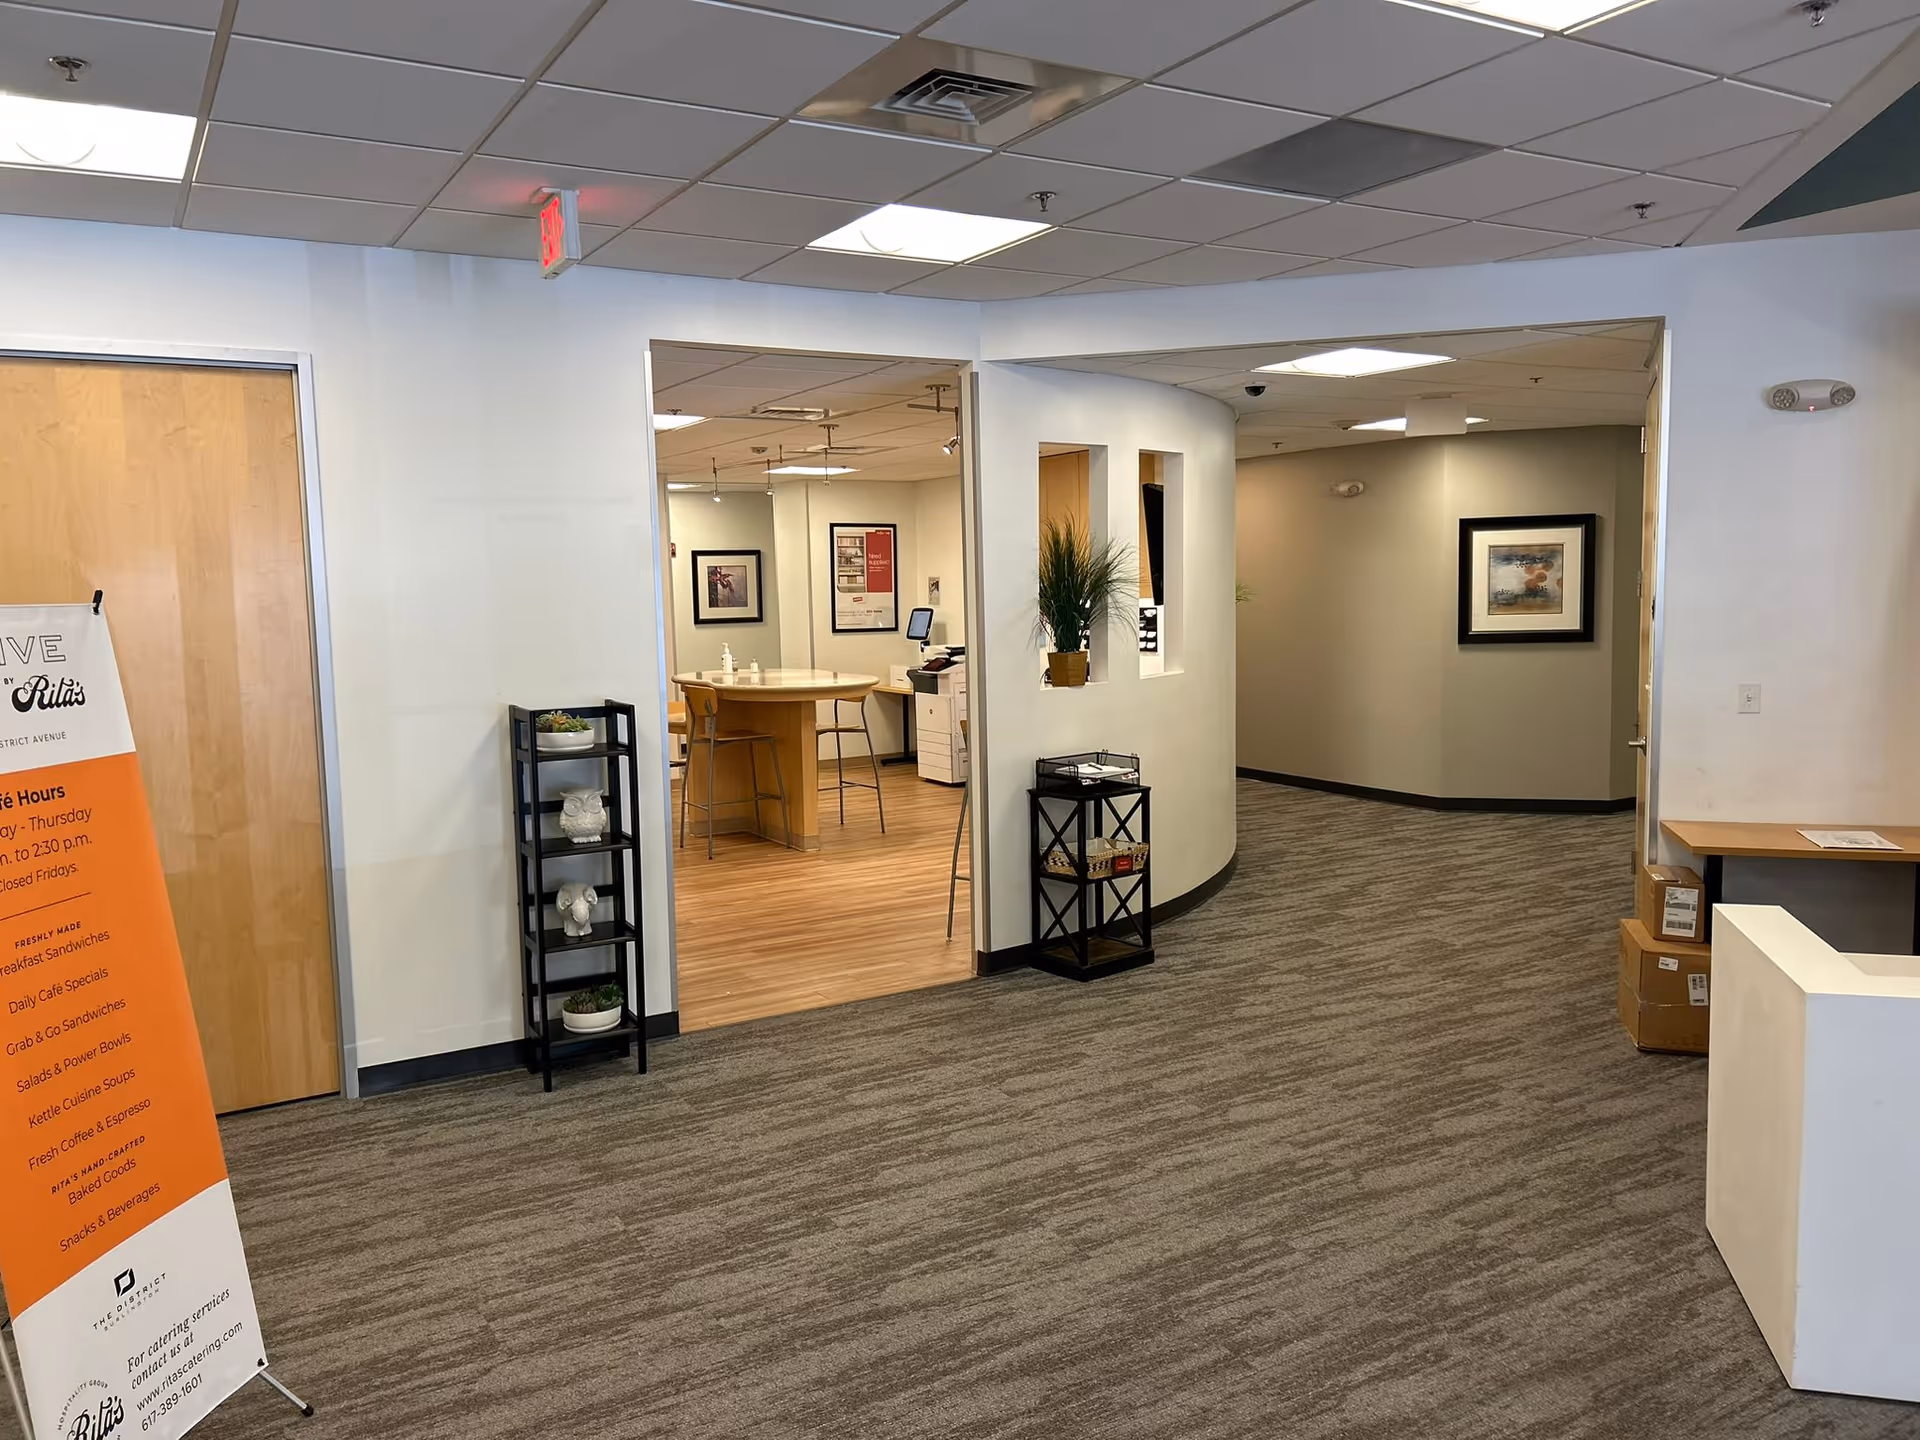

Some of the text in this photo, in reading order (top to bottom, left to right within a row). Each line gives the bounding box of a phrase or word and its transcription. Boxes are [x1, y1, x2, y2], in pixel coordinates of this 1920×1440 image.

[4, 674, 86, 713] BY Rita's
[33, 731, 67, 743] AVENUE
[17, 786, 66, 806] Hours
[28, 808, 92, 831] Thursday
[15, 848, 29, 862] to
[31, 838, 60, 858] 2:30
[63, 834, 92, 853] p.m.
[36, 862, 79, 882] Fridays.
[15, 921, 82, 949] FRESHLY MADE
[45, 931, 111, 960] Sandwiches
[8, 967, 109, 1014] Daily Café Specials
[6, 998, 126, 1056] Grab & Go Sandwiches
[16, 1031, 132, 1093] Salads & Power Bowls
[28, 1068, 136, 1129] Kettle Cuisine Soups
[28, 1098, 151, 1171] Fresh Coffee & Espresso
[51, 1135, 146, 1195] RITA'S HAND-CRAFTED
[68, 1158, 137, 1205] Baked Goods
[59, 1182, 161, 1252] Snacks & Beverages
[93, 1272, 166, 1330] THE DISTRICT
[127, 1288, 230, 1374] For catering services
[131, 1331, 195, 1390] contact us at
[136, 1321, 243, 1412] www.ritascatering.com
[57, 1379, 108, 1430] HOSPITALITY GROUP
[141, 1373, 203, 1431] 617-389-1601
